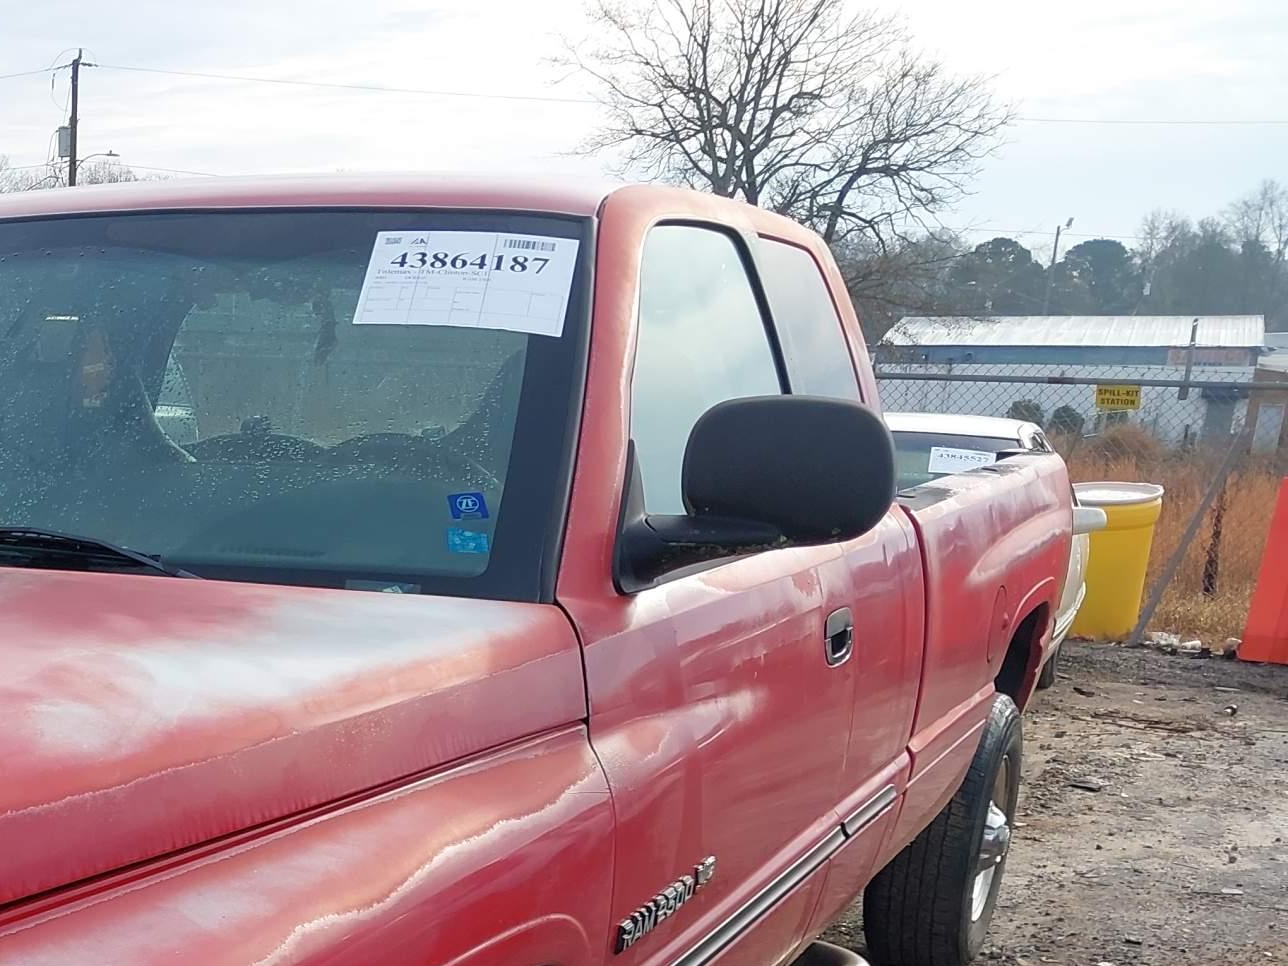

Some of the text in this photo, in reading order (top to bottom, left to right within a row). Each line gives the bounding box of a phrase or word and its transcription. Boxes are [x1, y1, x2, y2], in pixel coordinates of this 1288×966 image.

[390, 251, 551, 274] 43864187
[1097, 388, 1140, 397] SPILL-KIT
[1100, 398, 1136, 406] STATION
